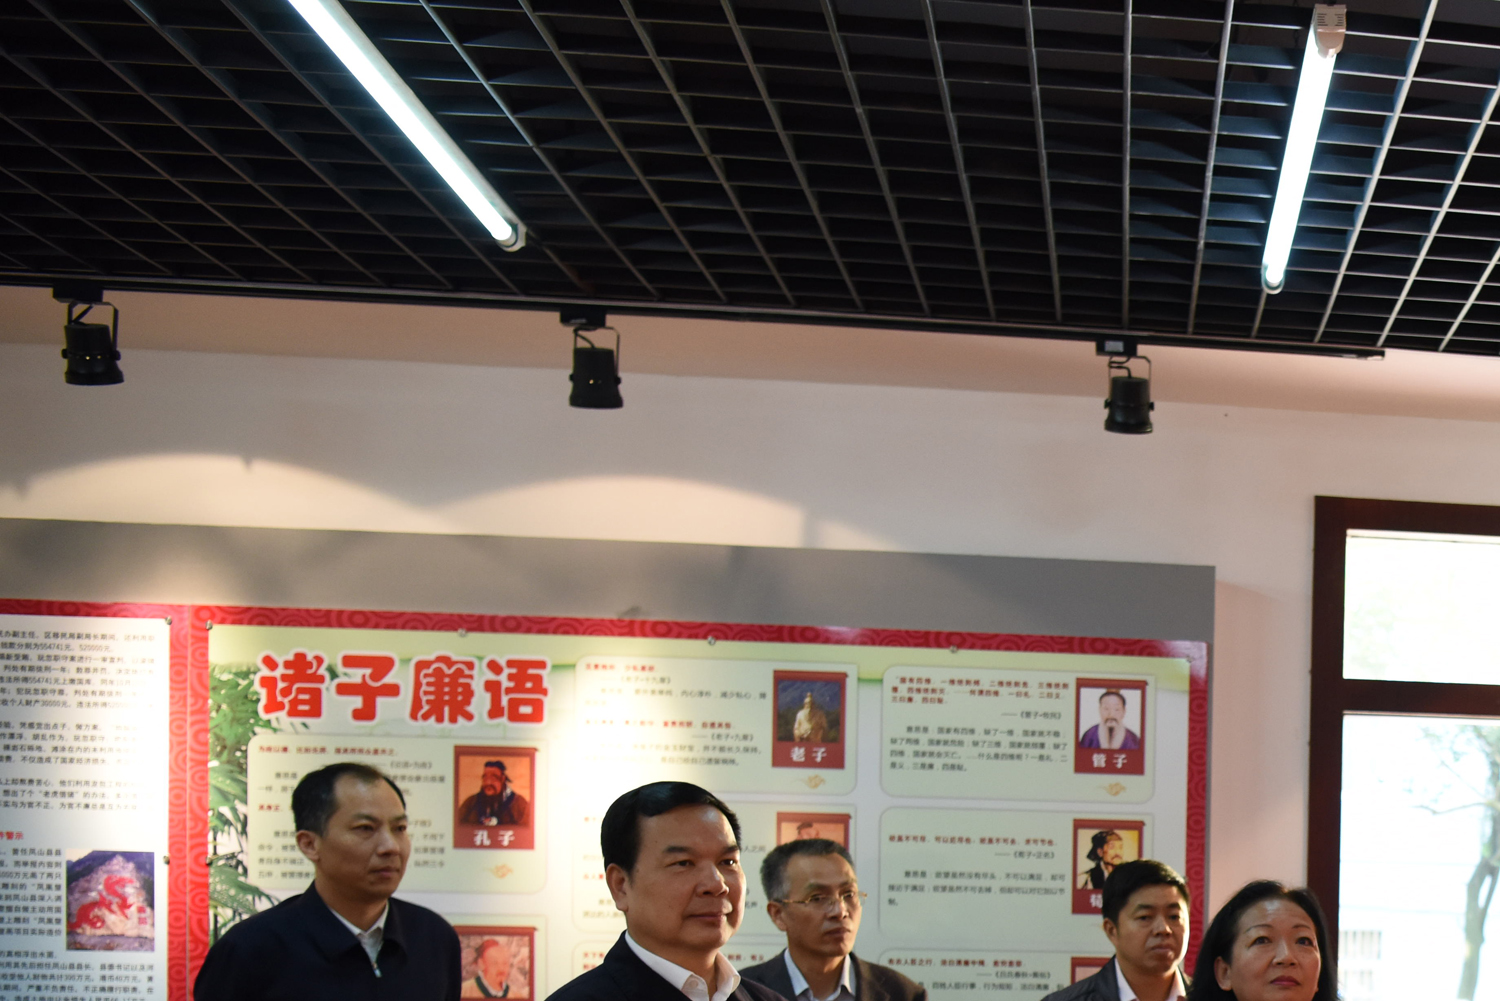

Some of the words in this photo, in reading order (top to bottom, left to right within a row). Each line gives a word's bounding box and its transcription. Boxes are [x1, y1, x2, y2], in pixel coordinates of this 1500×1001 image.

[257, 651, 549, 725] 诸子廉语
[790, 747, 827, 763] 老子
[1092, 753, 1128, 769] 管子
[473, 829, 516, 848] 孔子
